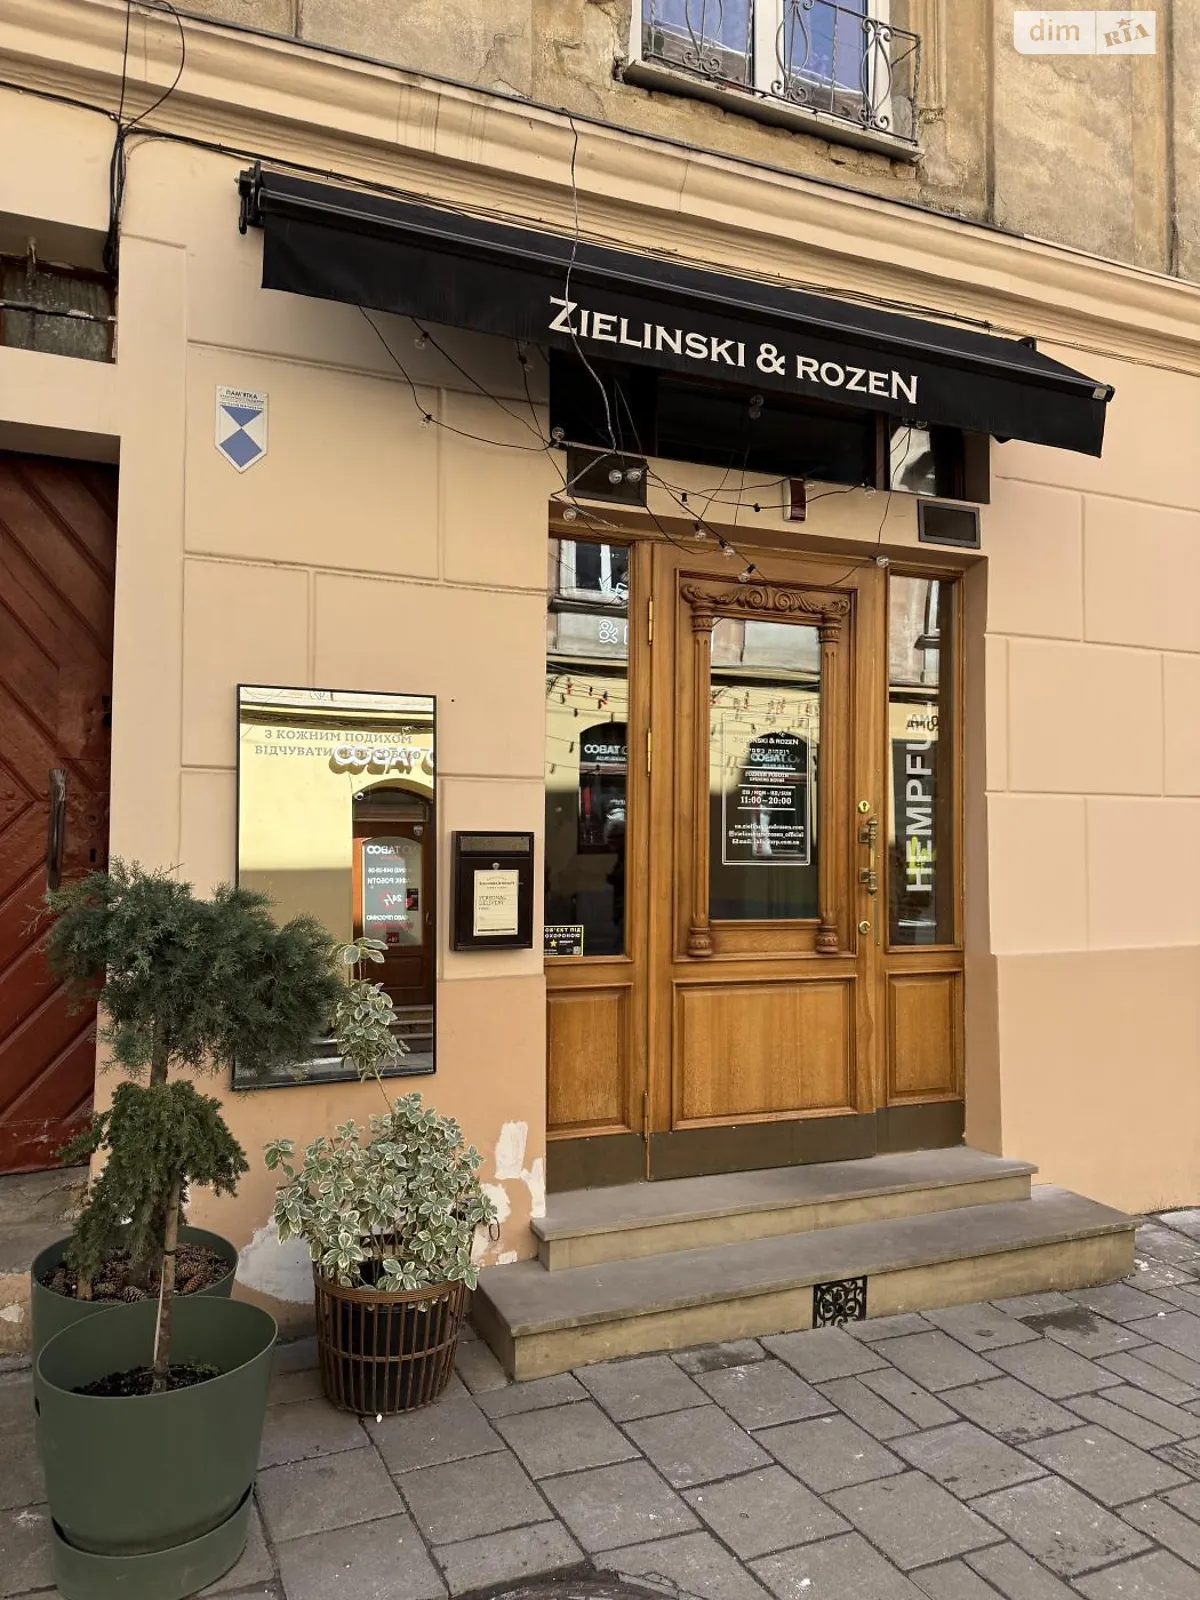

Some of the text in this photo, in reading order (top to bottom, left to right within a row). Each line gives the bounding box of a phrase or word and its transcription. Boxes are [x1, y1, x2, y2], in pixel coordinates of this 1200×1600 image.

[549, 296, 919, 405] ZIELINSKI & ROZEN
[276, 730, 341, 742] КОЖНИМ
[345, 733, 413, 744] ПОДИХОМ
[255, 745, 333, 757] ВІДЧУВАТИ
